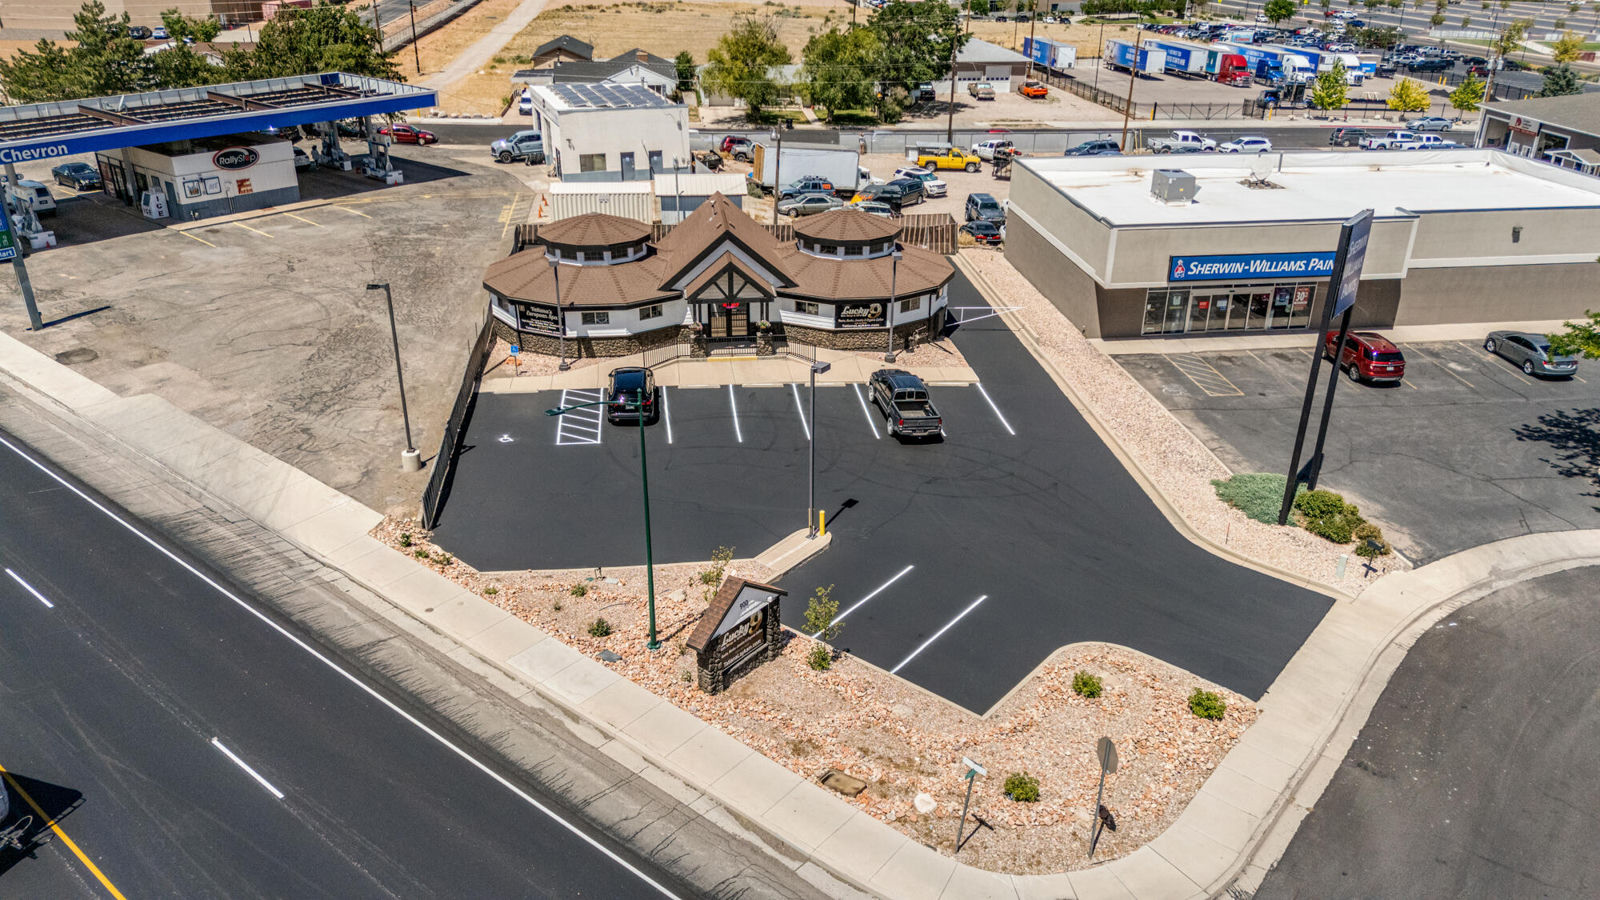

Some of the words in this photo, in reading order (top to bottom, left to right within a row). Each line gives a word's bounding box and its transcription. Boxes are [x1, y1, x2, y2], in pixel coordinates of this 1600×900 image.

[0, 144, 69, 163] Chevron
[156, 195, 165, 217] ICE
[0, 250, 13, 258] art
[1307, 257, 1334, 271] PAIN
[841, 306, 869, 317] Lucky
[722, 624, 750, 645] Lucky
